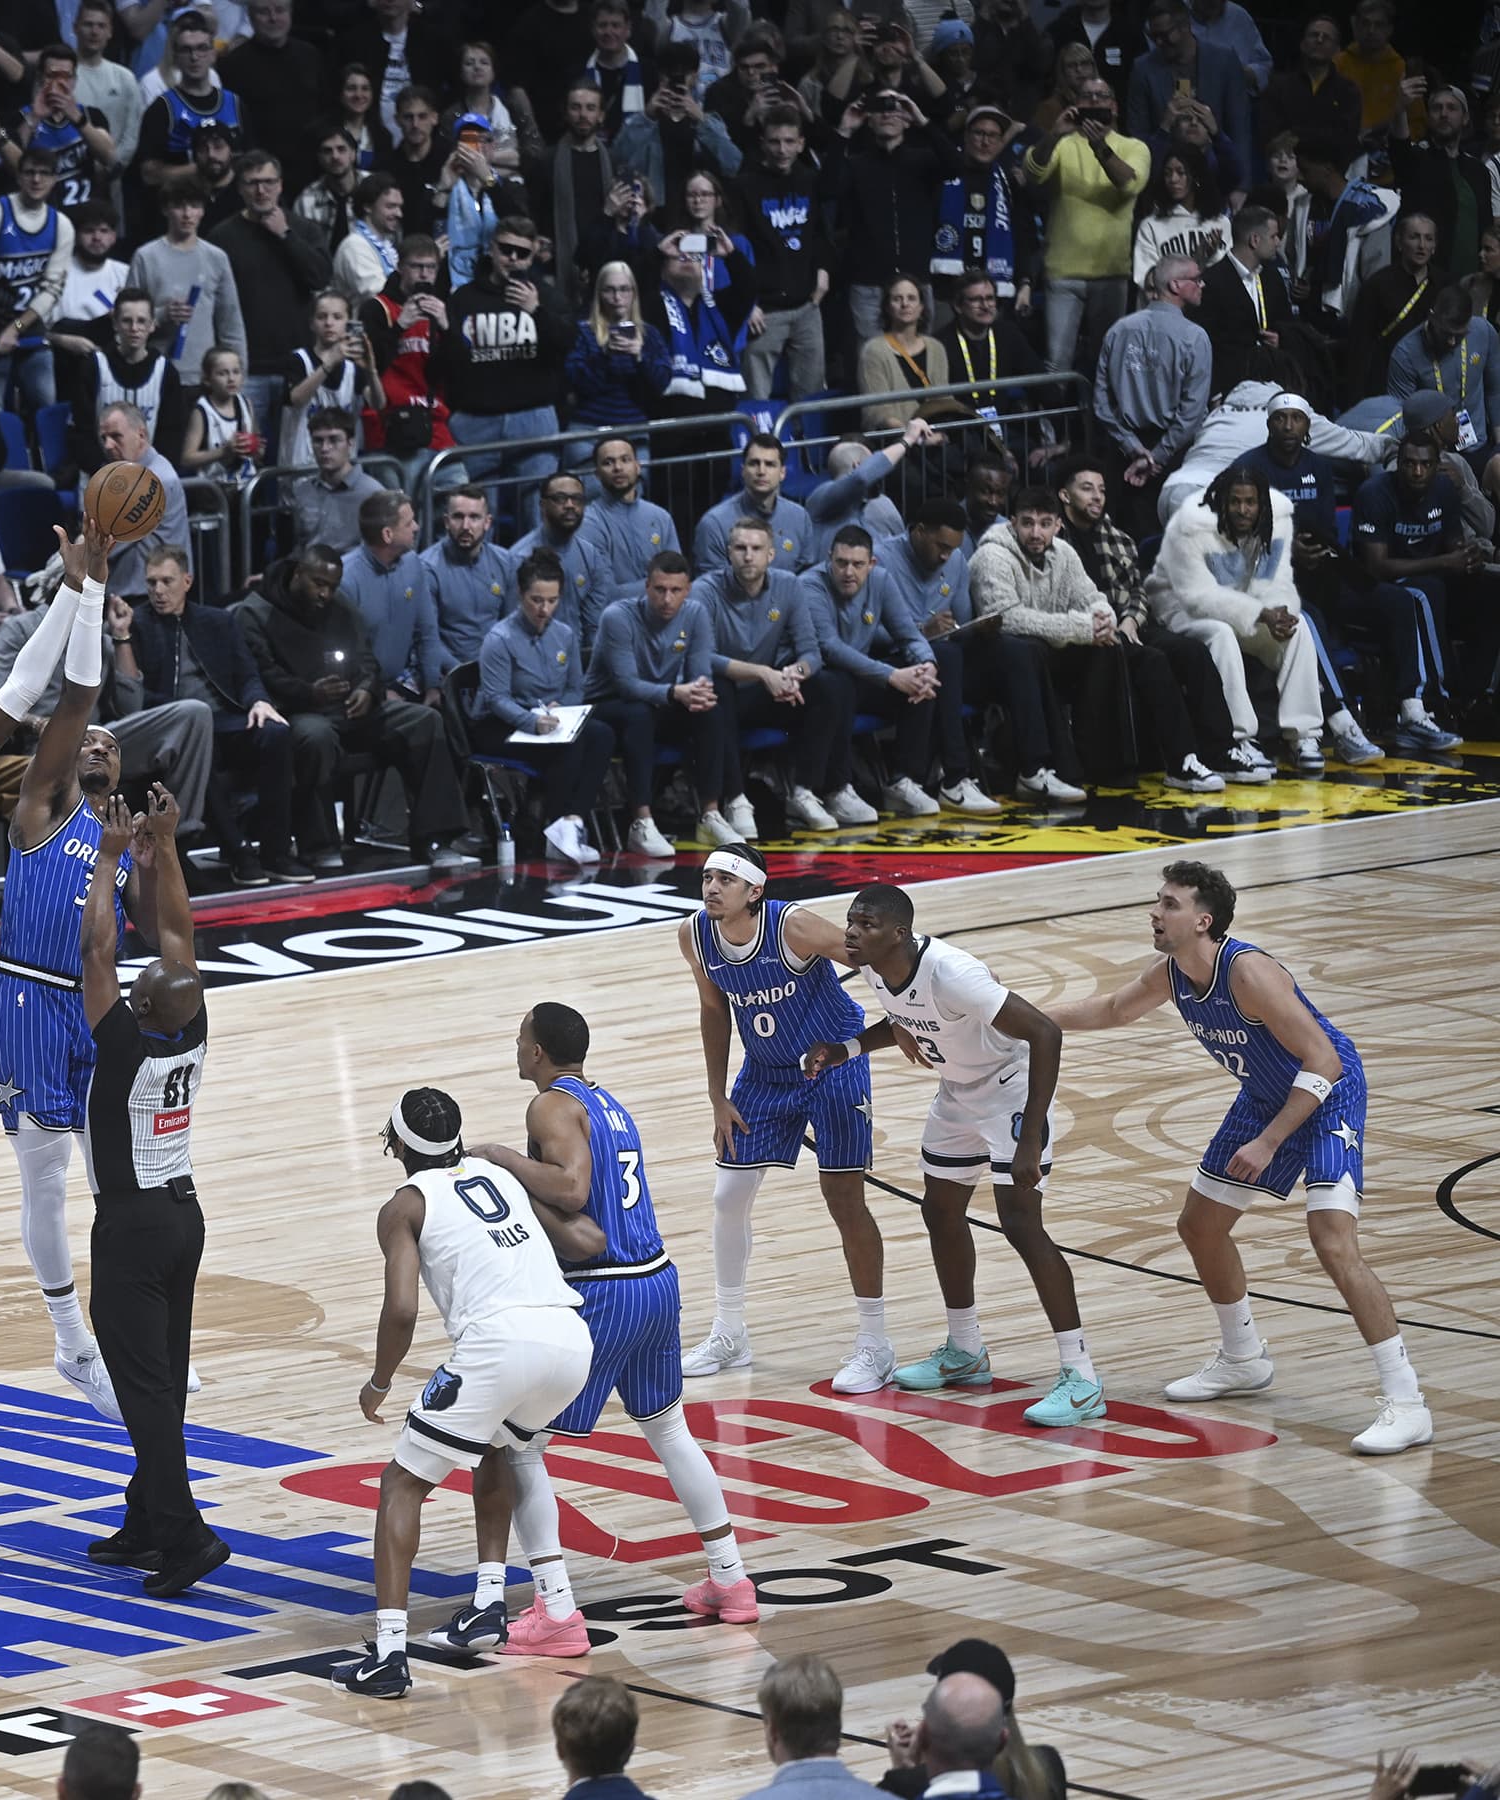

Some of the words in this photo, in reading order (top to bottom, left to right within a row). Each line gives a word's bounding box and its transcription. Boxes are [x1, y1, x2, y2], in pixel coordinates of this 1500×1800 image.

[972, 235, 983, 257] 9
[475, 311, 538, 347] NBA
[124, 479, 158, 523] Wilson
[753, 1012, 776, 1038] 0
[1214, 1050, 1250, 1078] 22
[163, 1063, 196, 1108] 61
[1312, 1080, 1328, 1095] 22
[158, 1114, 189, 1130] Emirates
[617, 1151, 641, 1210] 3
[454, 1175, 510, 1223] 0
[486, 1223, 531, 1248] WELLS
